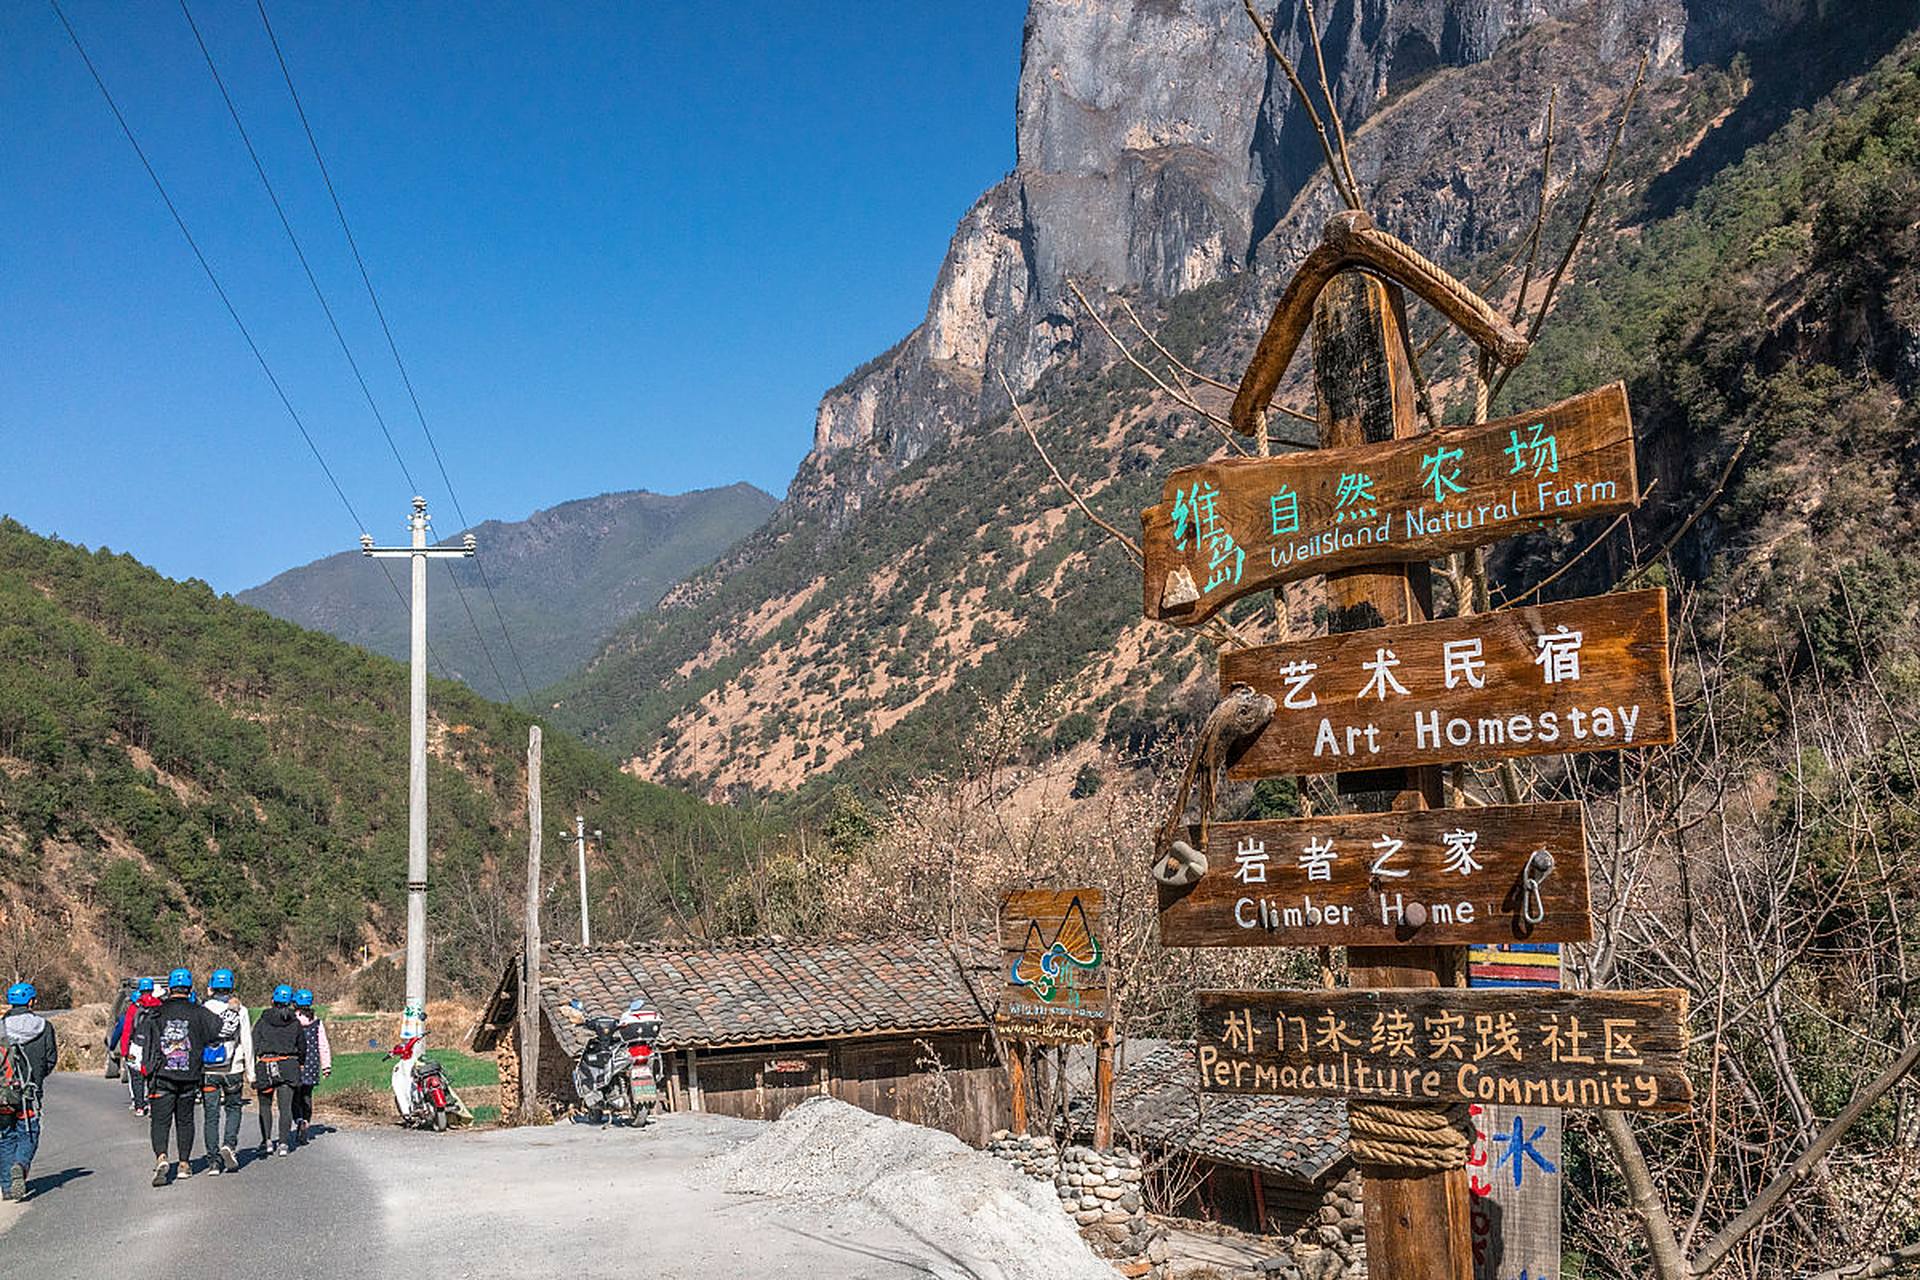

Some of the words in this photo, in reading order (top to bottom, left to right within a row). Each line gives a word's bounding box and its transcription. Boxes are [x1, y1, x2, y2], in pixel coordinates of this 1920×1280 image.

[1171, 481, 1245, 593] 维岛
[1270, 423, 1558, 536] 自然农场
[1406, 489, 1519, 539] Natural
[1538, 478, 1616, 512] Farm
[1279, 625, 1582, 709] 艺术民宿
[1313, 718, 1380, 757] Art
[1415, 704, 1640, 749] Homestay
[1234, 828, 1483, 884] 岩者之家
[1234, 897, 1354, 929] Climber
[1222, 1008, 1645, 1065] 朴门永续实践社区
[1200, 1046, 1441, 1098] Permaculture
[1457, 1063, 1659, 1106] Community
[1493, 1115, 1557, 1190] 水
